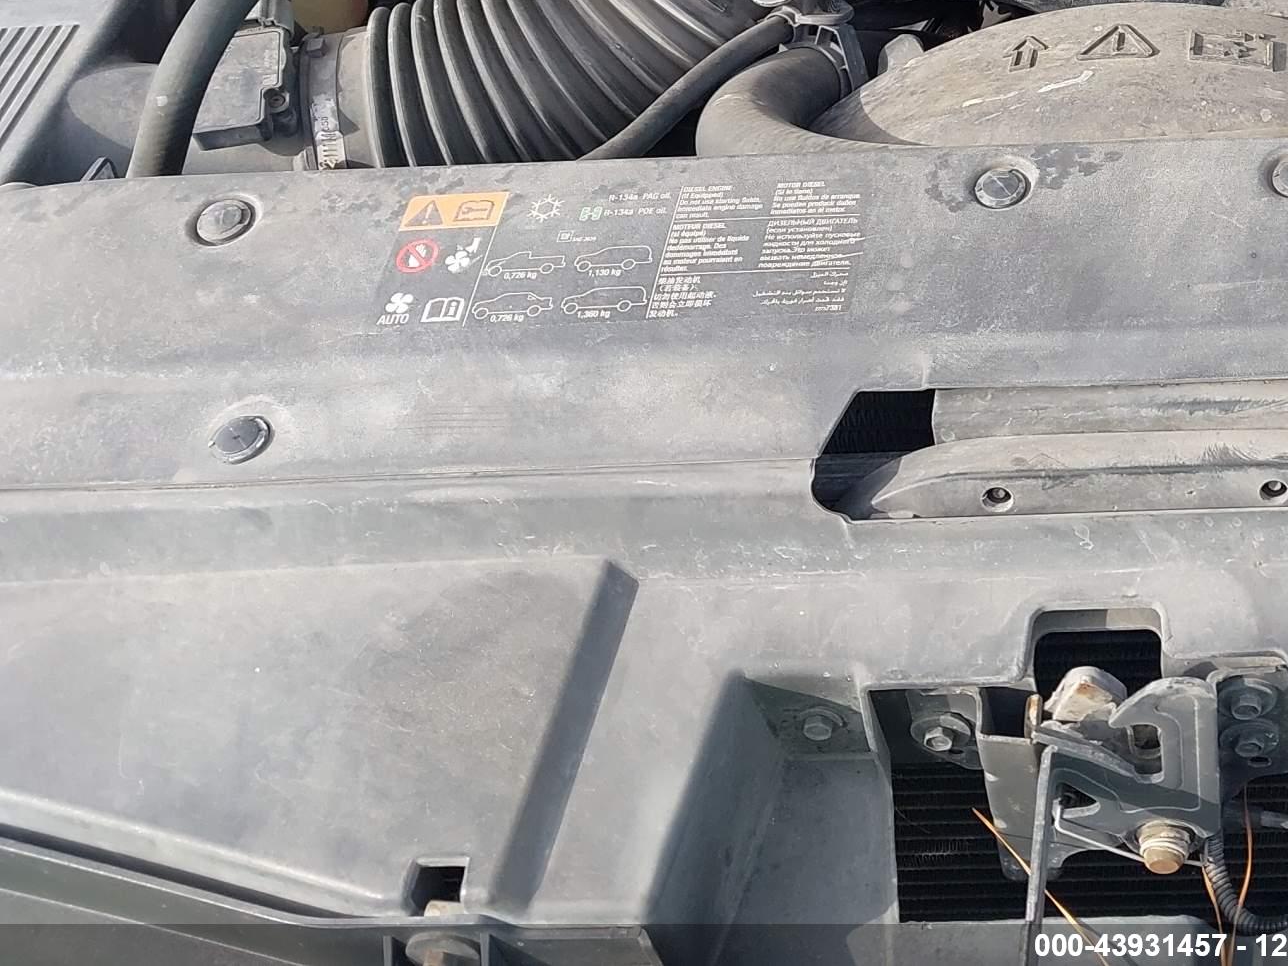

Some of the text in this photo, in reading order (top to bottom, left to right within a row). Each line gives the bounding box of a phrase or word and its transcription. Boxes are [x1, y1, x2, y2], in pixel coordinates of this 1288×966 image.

[526, 272, 537, 280] kg
[611, 268, 622, 277] kg
[513, 314, 524, 323] kg
[600, 310, 610, 319] kg
[377, 314, 410, 326] AUTO
